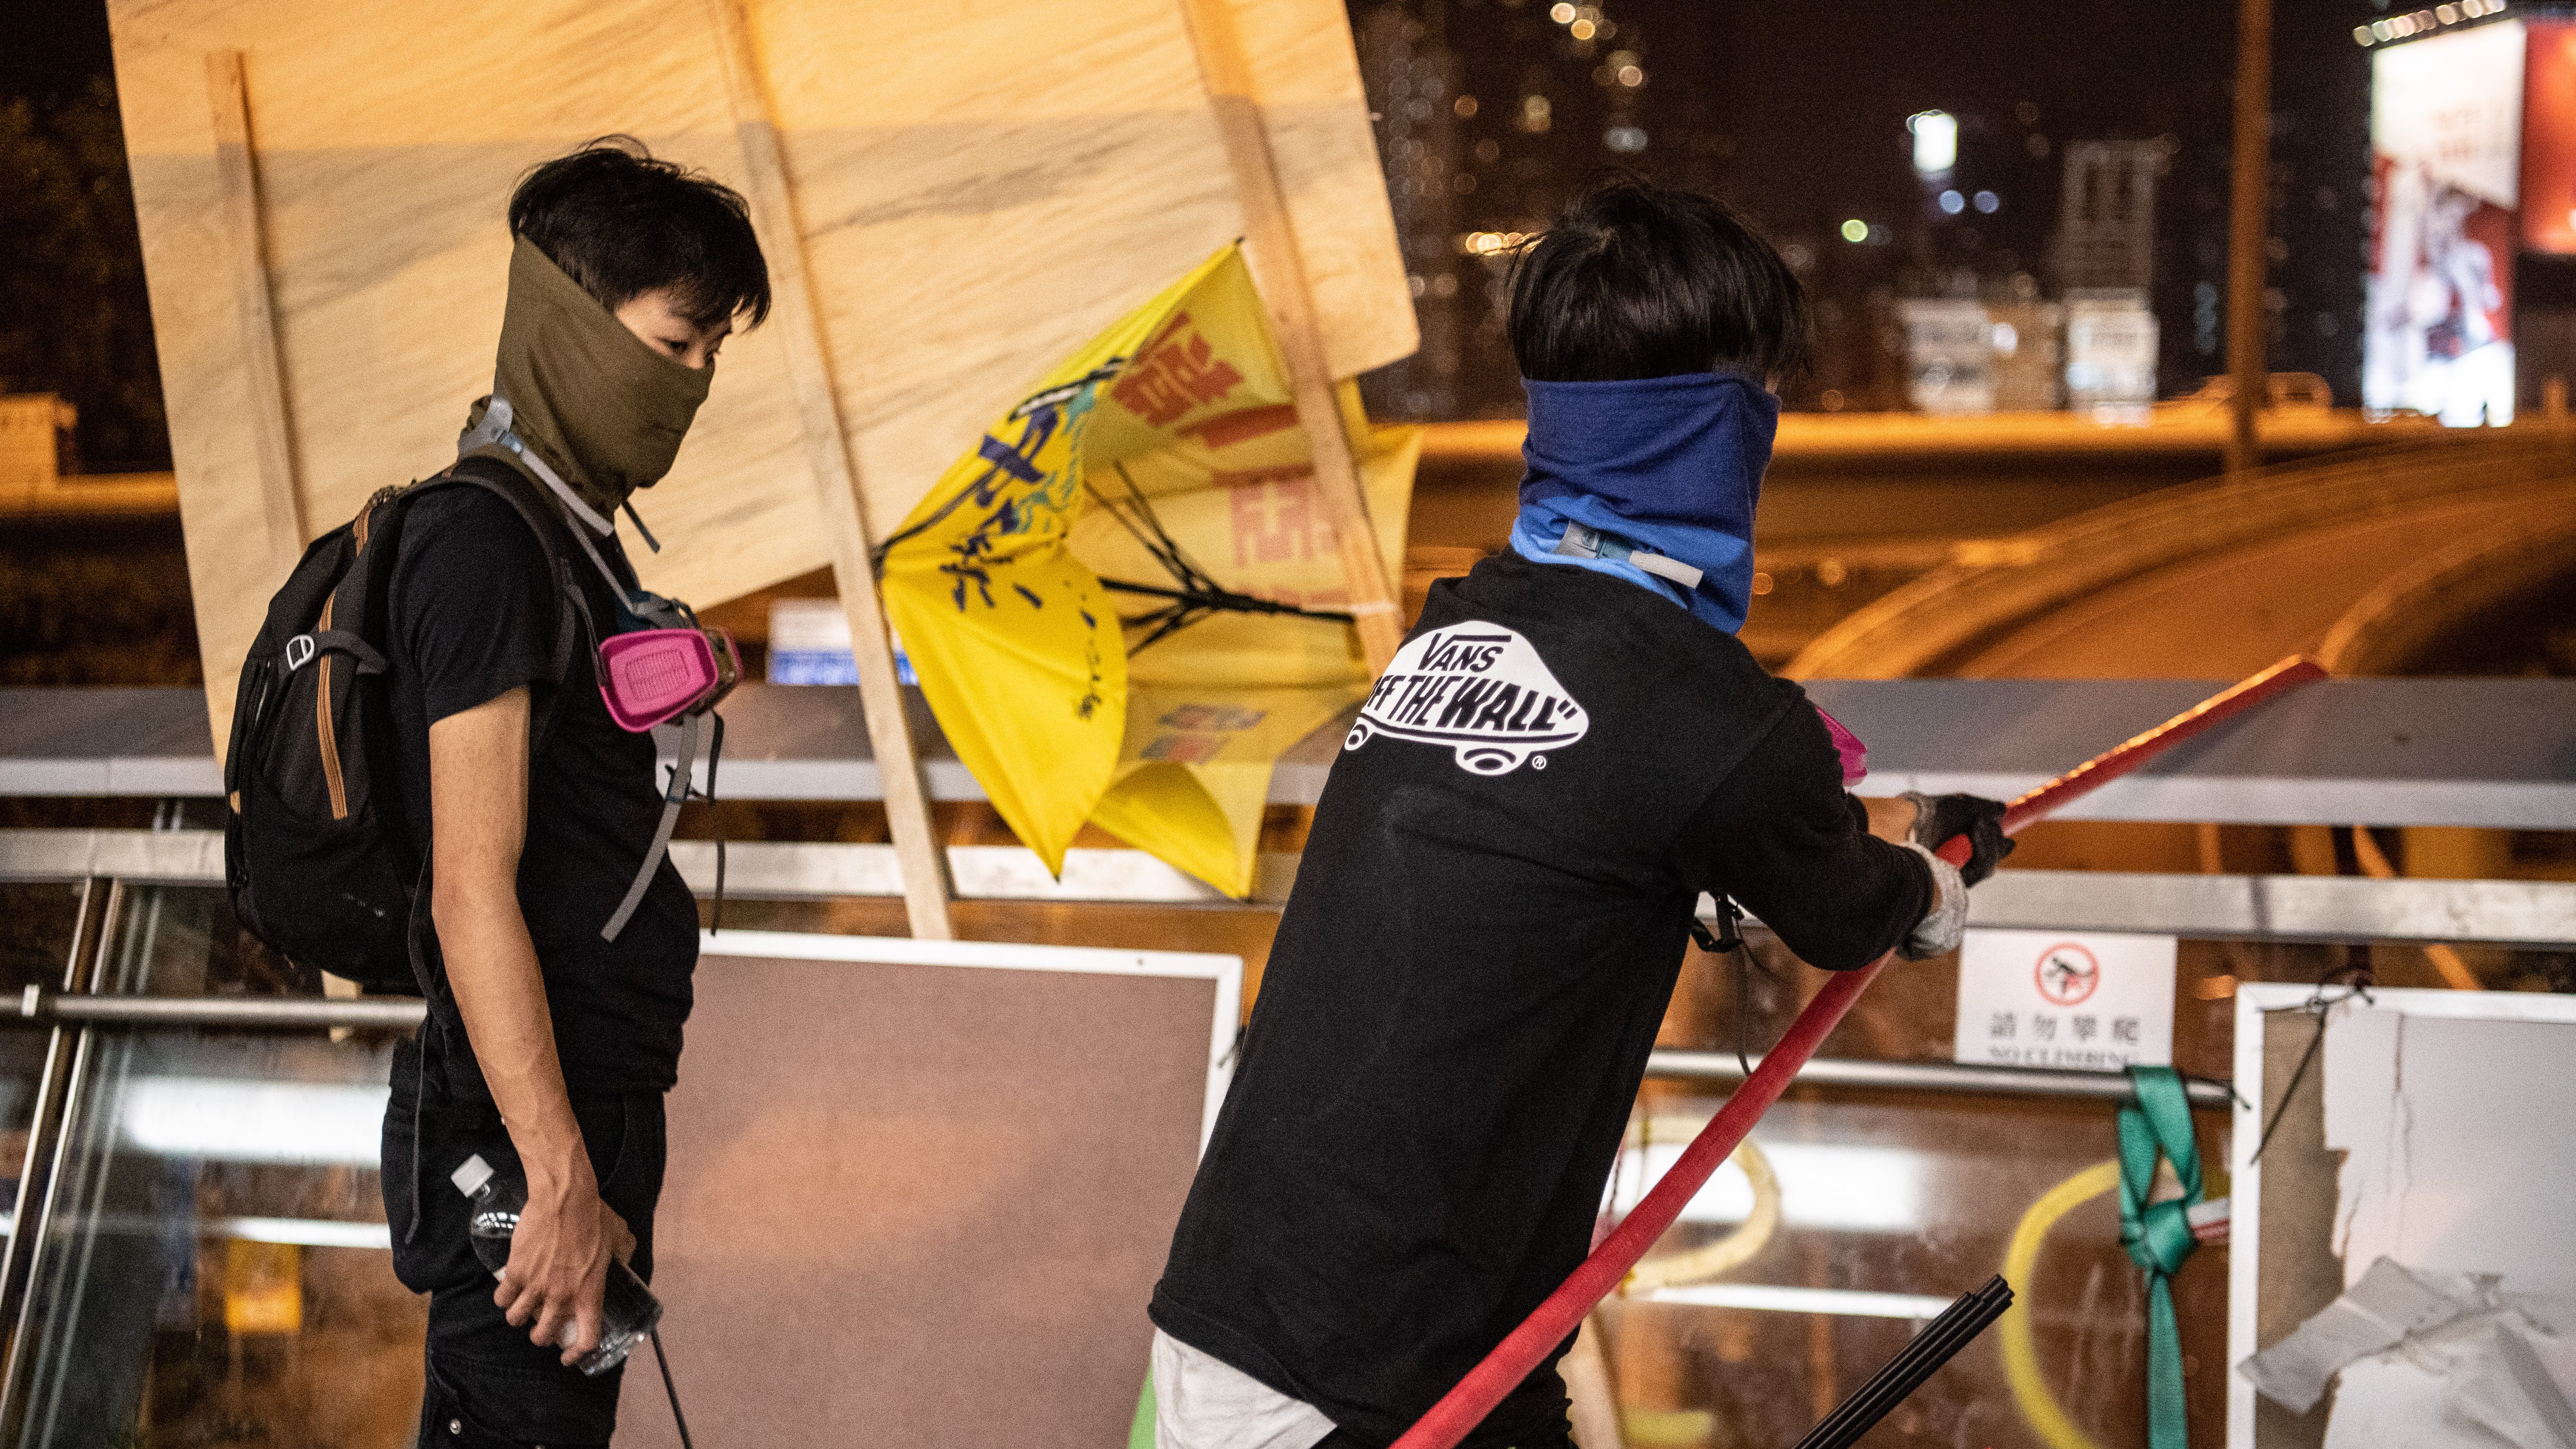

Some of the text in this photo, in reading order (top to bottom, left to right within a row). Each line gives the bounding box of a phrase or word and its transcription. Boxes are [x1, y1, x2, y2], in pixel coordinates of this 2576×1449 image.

[1418, 633, 1511, 673] VANS
[1366, 675, 1406, 712] FF
[1387, 675, 1466, 726] THE
